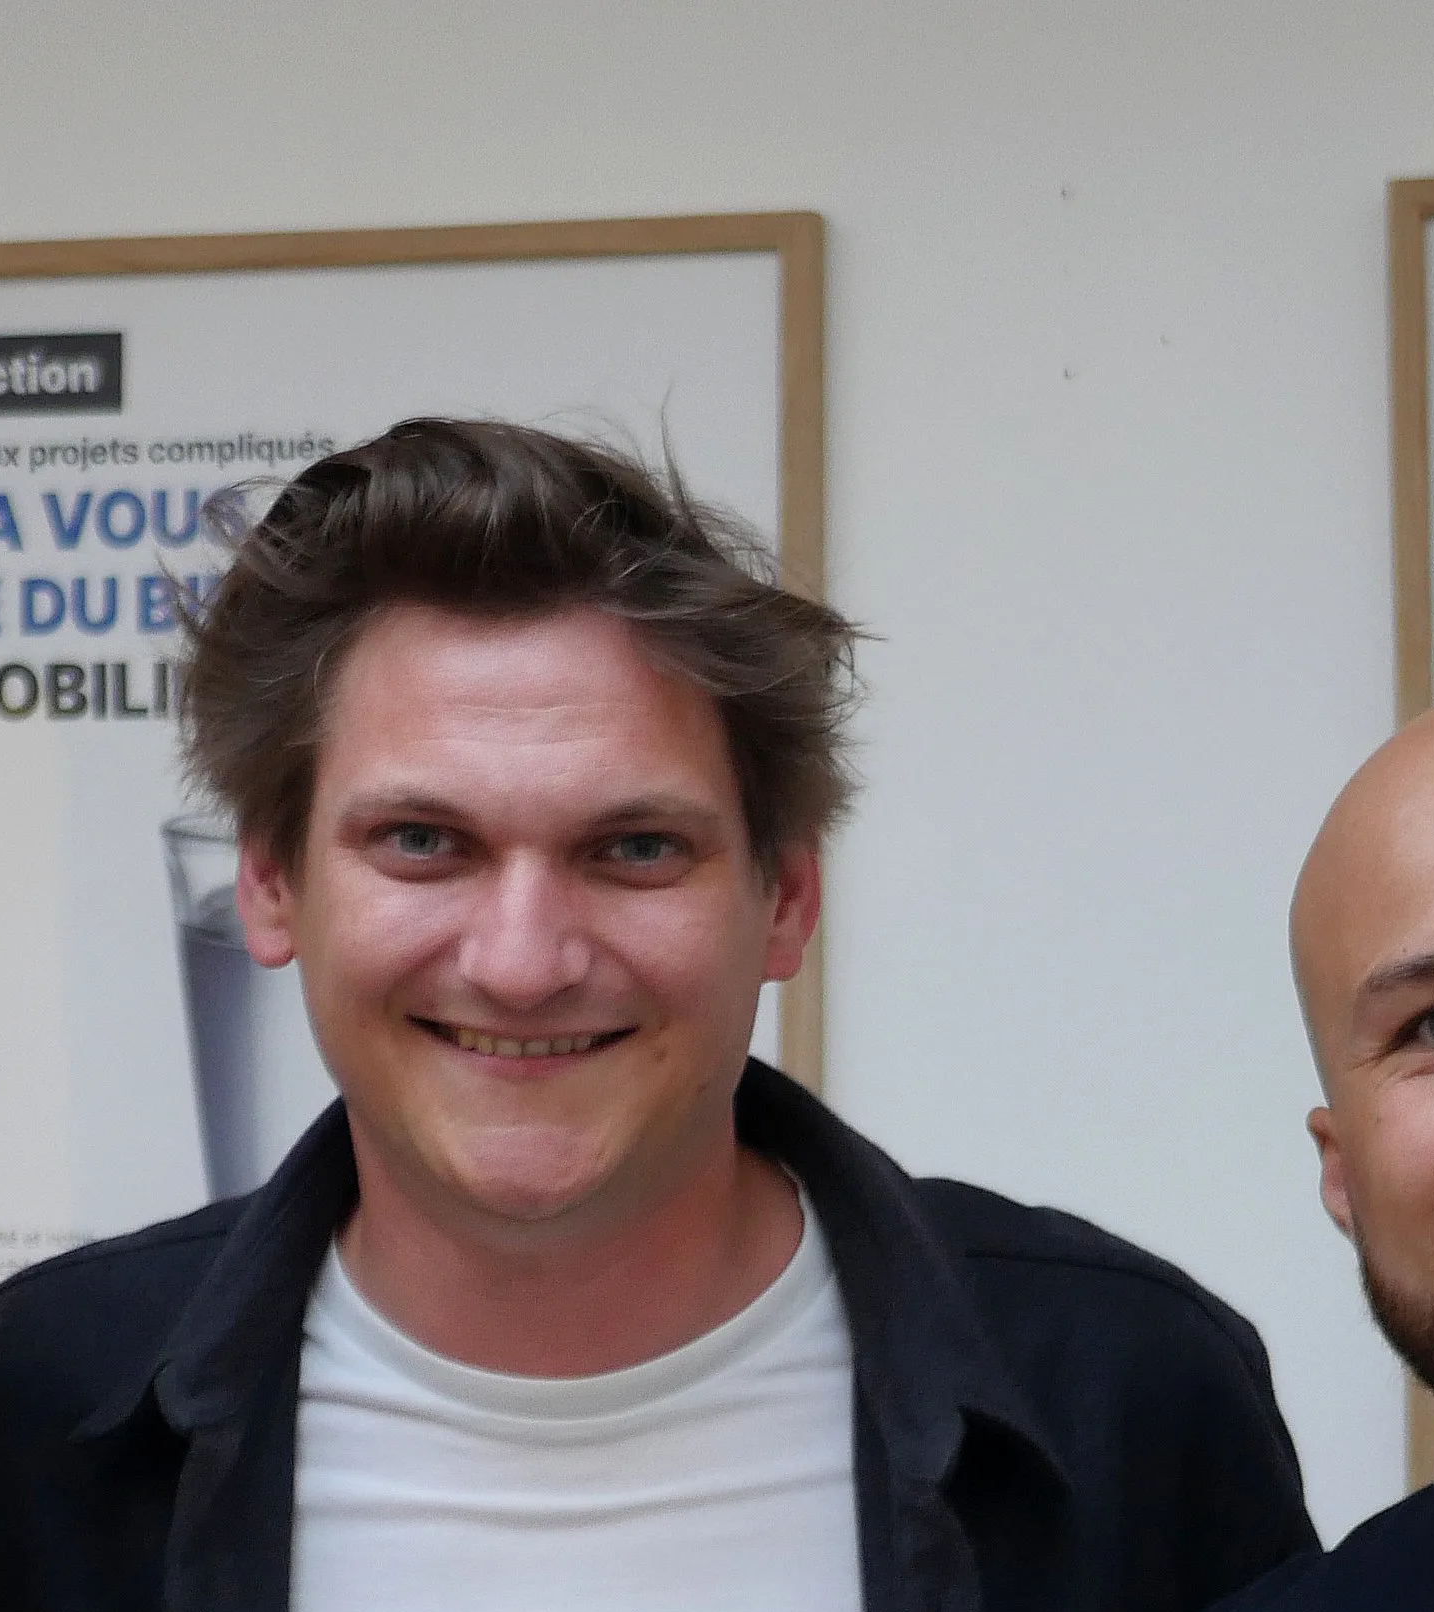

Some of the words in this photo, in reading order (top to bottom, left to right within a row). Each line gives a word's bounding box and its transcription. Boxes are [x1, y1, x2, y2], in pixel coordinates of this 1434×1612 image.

[28, 437, 139, 475] projets
[148, 431, 336, 469] compliqués
[19, 576, 119, 637] DU
